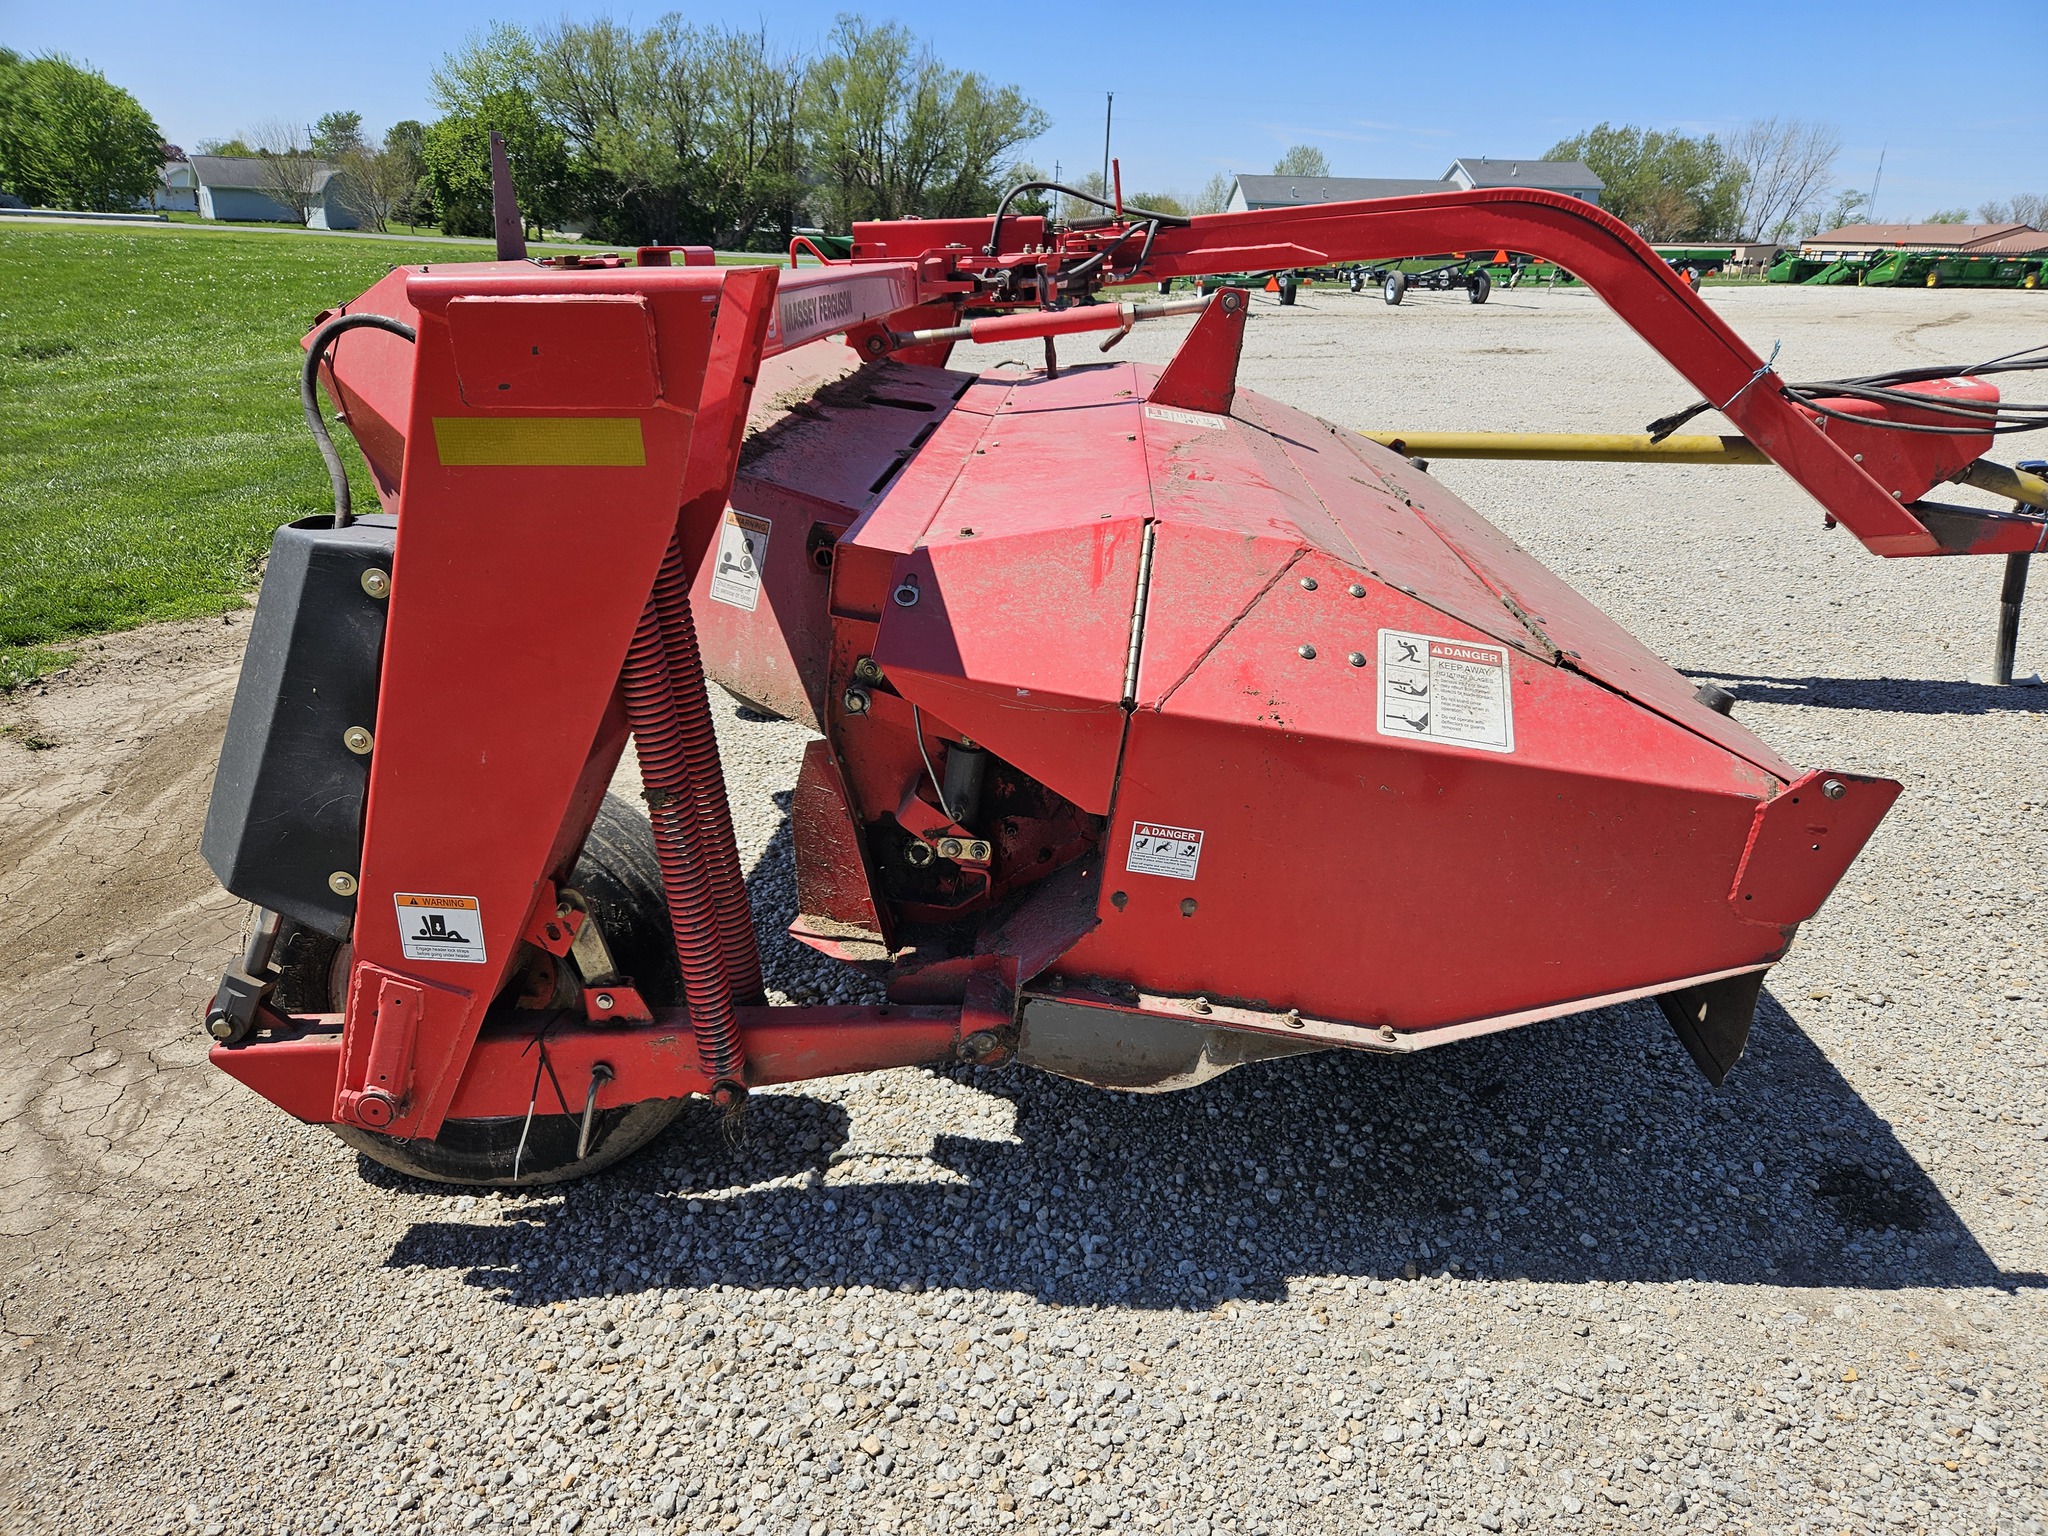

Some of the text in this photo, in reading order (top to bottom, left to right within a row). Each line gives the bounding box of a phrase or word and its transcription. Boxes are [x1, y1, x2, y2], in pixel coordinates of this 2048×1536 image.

[784, 297, 818, 332] MASSEY
[819, 291, 853, 323] FERGUSON
[736, 516, 766, 531] WARNING
[1444, 647, 1498, 662] DANGER
[1438, 661, 1463, 670] KEEP
[1436, 671, 1494, 684] ROTATING BLADES
[1152, 828, 1196, 841] DANGER
[422, 898, 464, 907] WARNING
